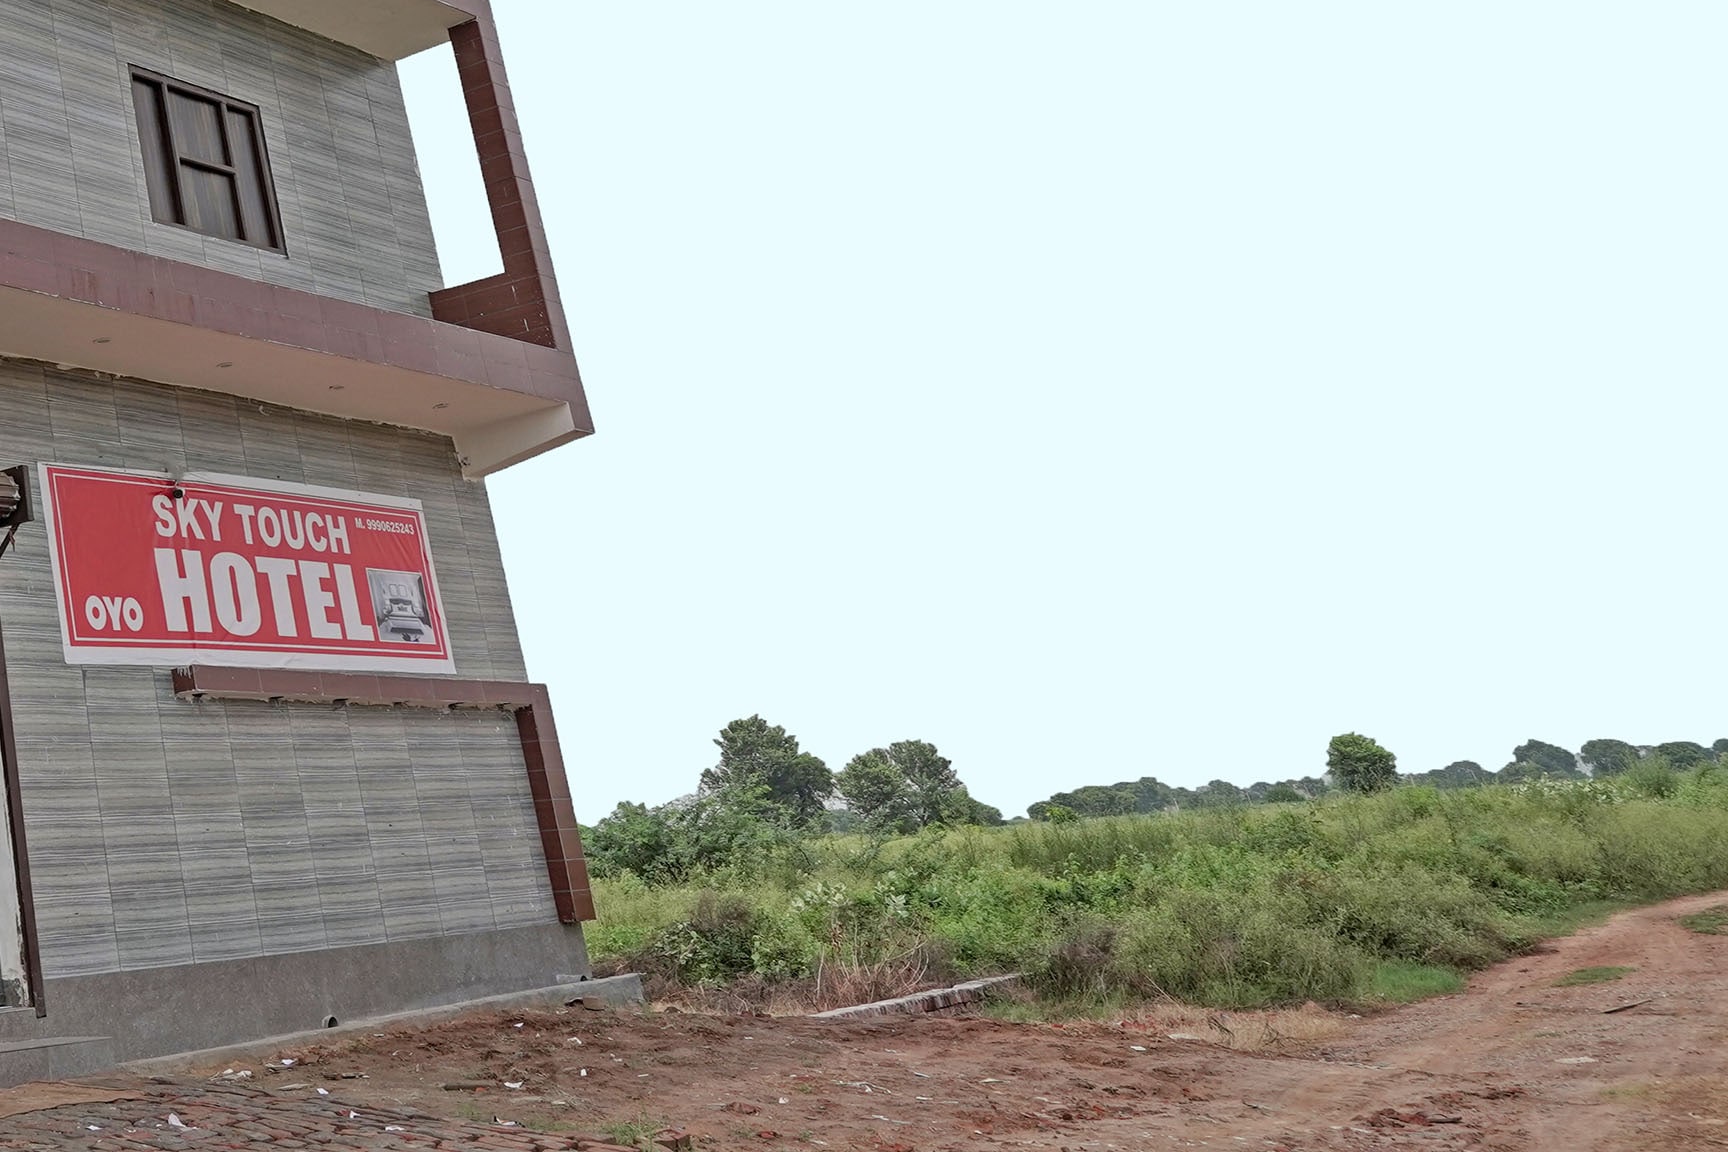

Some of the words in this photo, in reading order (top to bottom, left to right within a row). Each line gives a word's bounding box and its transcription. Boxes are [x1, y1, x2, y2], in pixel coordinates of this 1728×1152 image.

[152, 494, 223, 542] SKY
[233, 503, 351, 554] TOUCH
[85, 595, 144, 632] OYO
[154, 547, 375, 641] HOTEL
